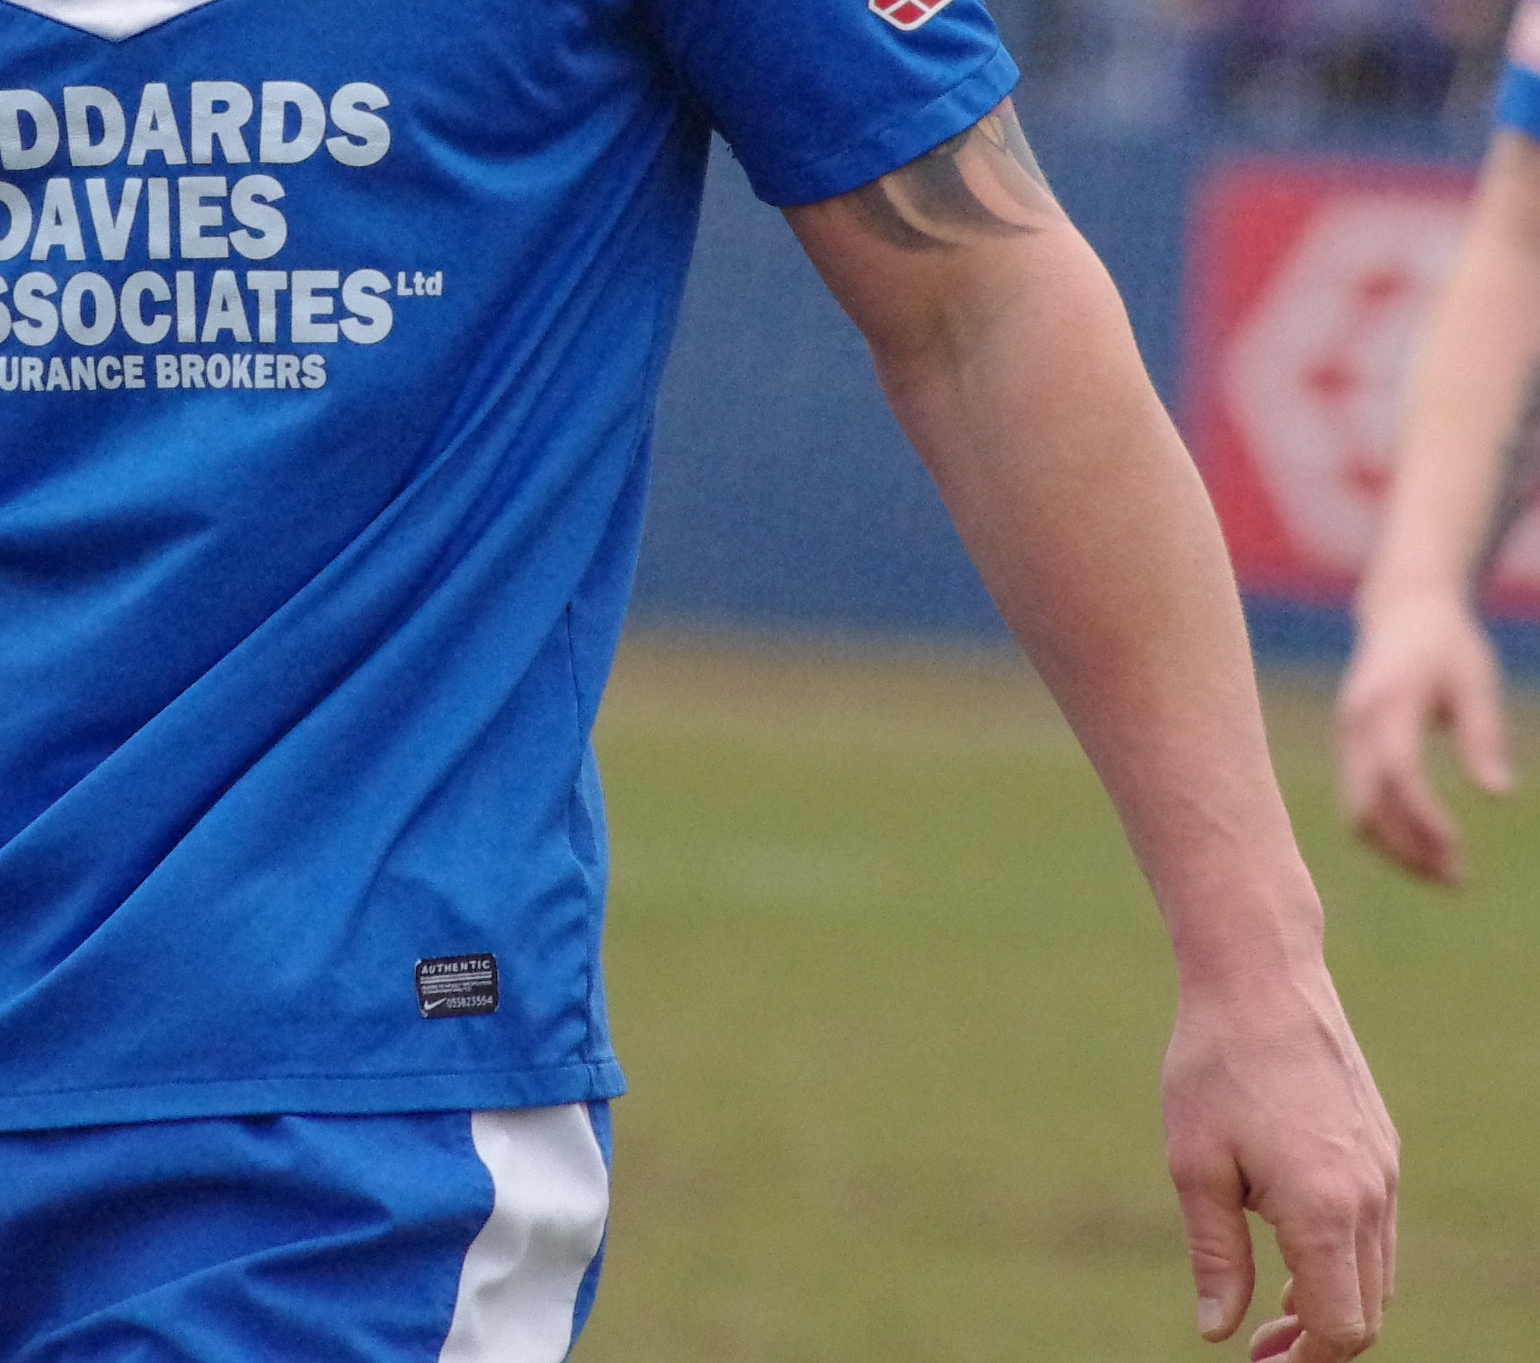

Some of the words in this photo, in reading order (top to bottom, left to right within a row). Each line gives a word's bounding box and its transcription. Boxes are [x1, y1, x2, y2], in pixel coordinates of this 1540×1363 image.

[396, 270, 444, 297] Ltd
[155, 353, 328, 390] BROKERS
[422, 960, 491, 974] AUTHENTIC
